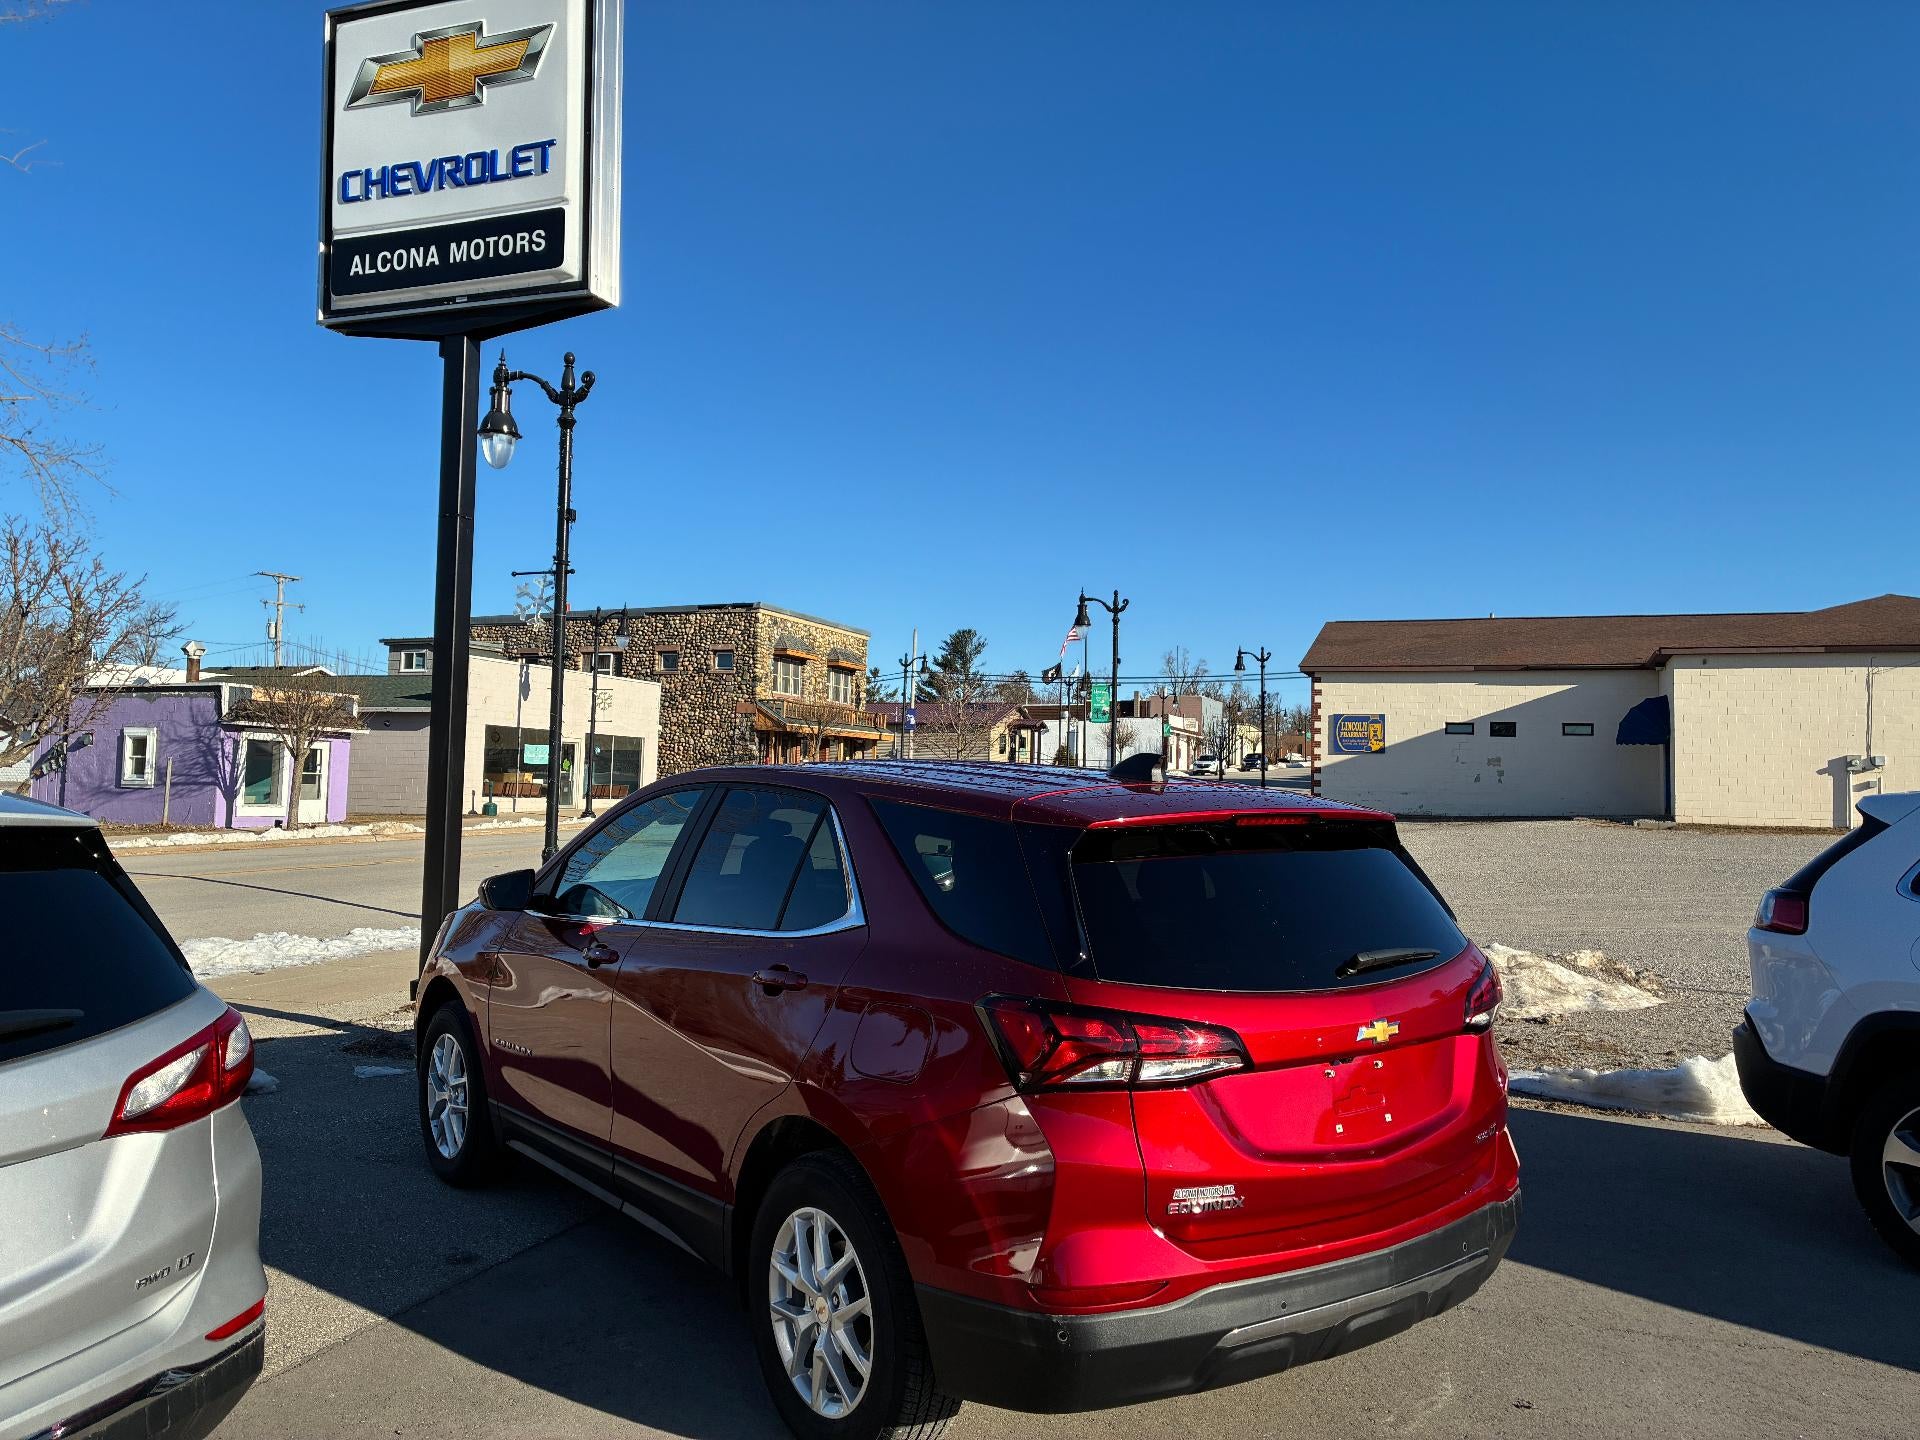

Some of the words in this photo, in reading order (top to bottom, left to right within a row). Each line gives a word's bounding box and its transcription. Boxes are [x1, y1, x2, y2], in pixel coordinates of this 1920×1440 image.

[340, 138, 557, 203] CHEVROLET
[350, 245, 440, 276] ALCONA
[449, 229, 546, 264] MOTORS
[1341, 721, 1368, 731] LINCOLN
[1173, 1188, 1198, 1199] ALCONA
[1198, 1185, 1223, 1197] MOTORS
[177, 1252, 196, 1272] LT
